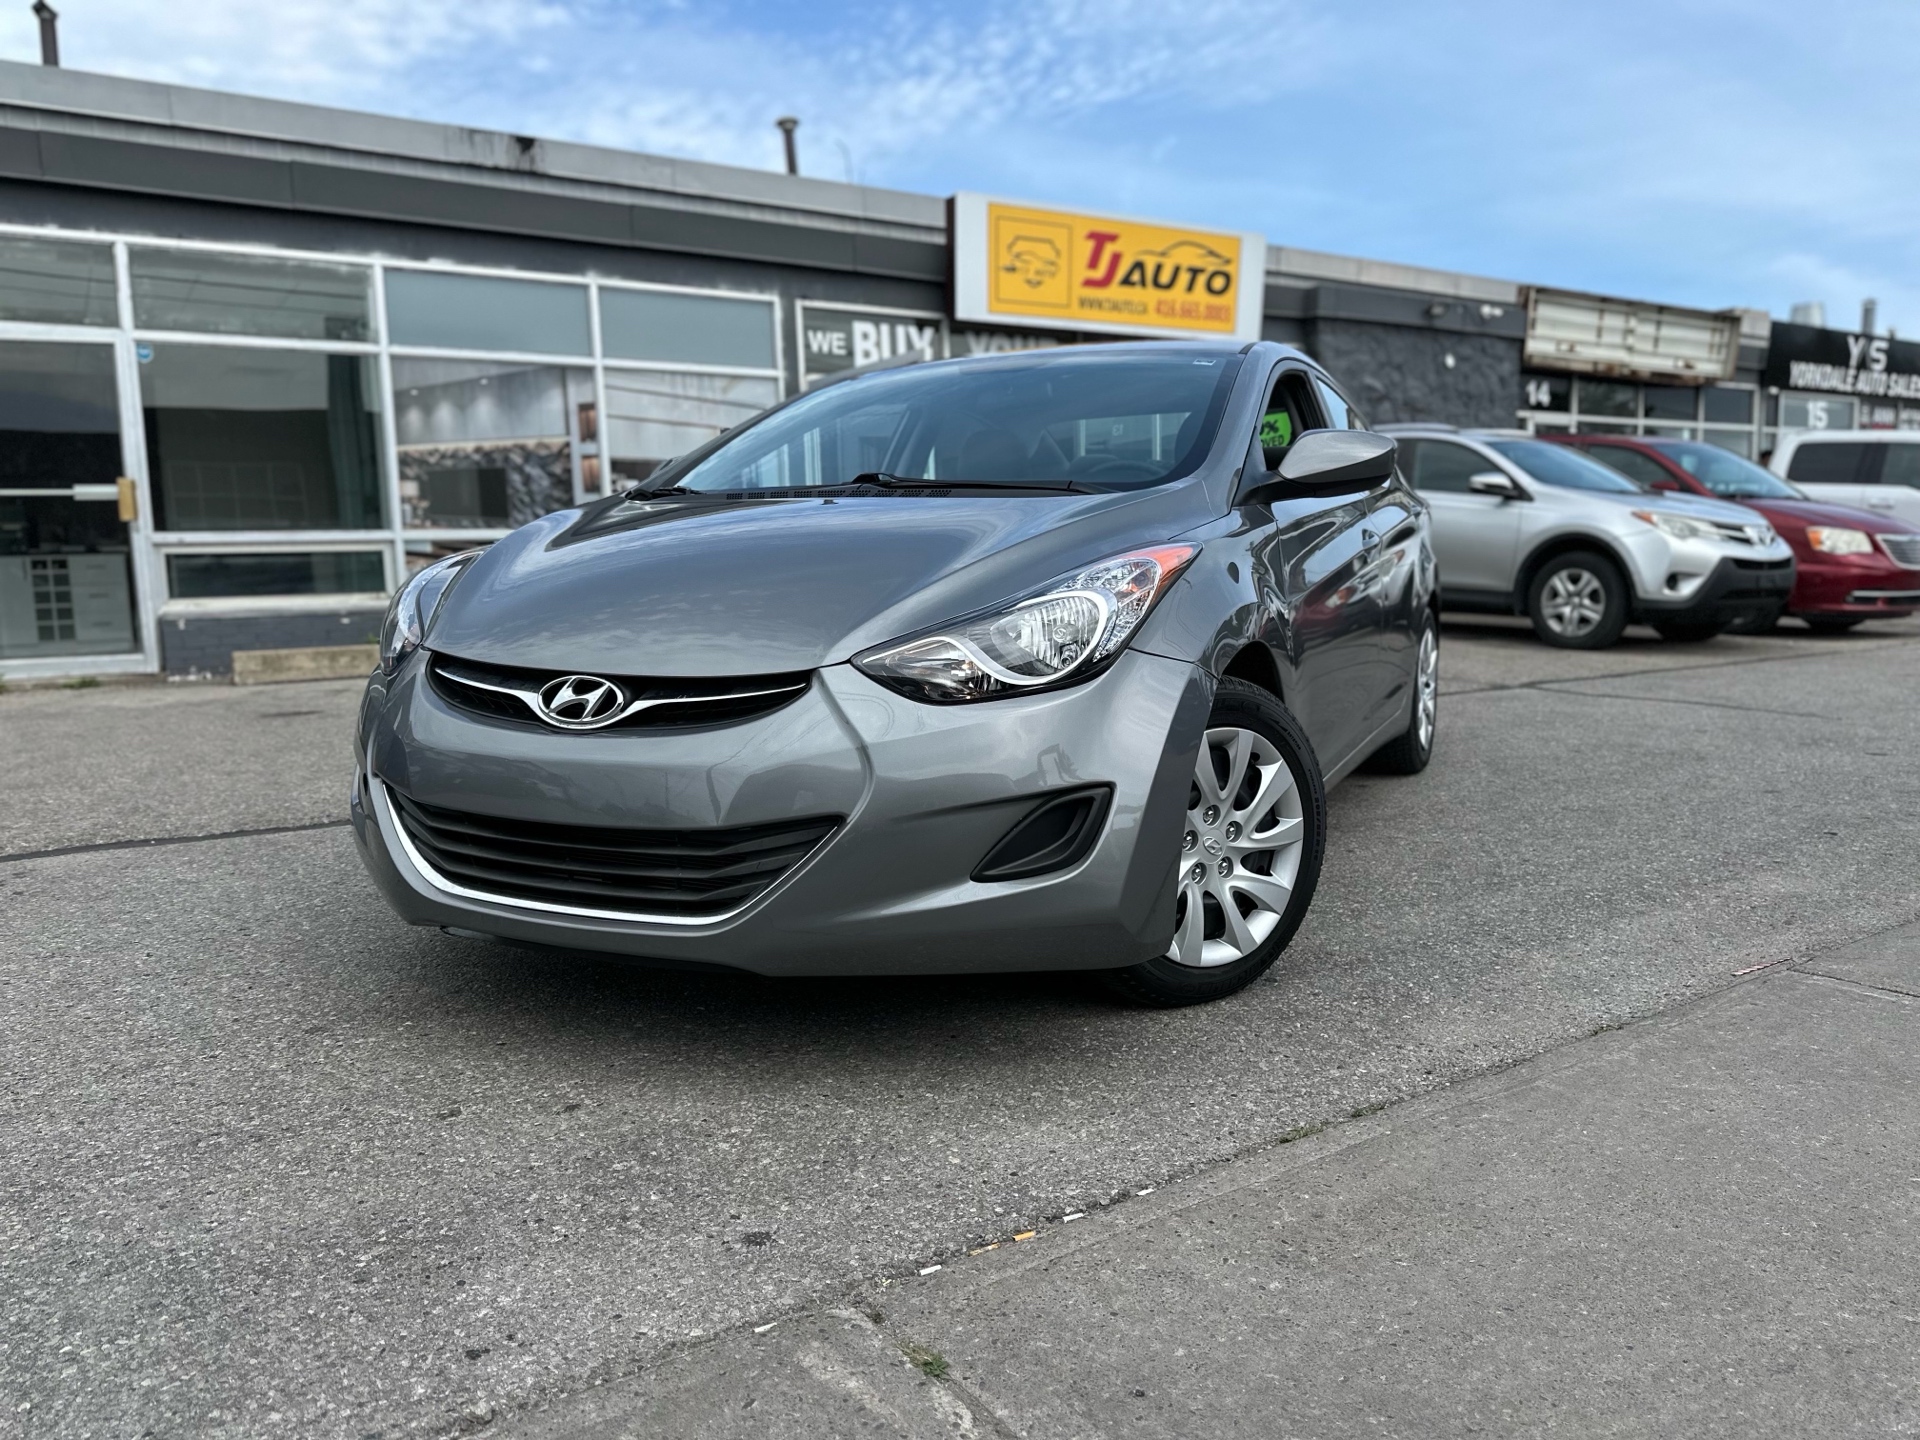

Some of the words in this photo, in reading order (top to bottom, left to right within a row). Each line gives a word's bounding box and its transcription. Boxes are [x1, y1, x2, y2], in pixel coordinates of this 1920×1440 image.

[1081, 231, 1122, 288] TJ
[1119, 261, 1232, 296] AUTO
[807, 328, 847, 356] WE
[852, 320, 936, 369] BUY
[1525, 380, 1552, 408] 14
[1789, 360, 1857, 393] YORKDALE
[1855, 370, 1888, 395] AUTO
[1806, 400, 1829, 429] 15
